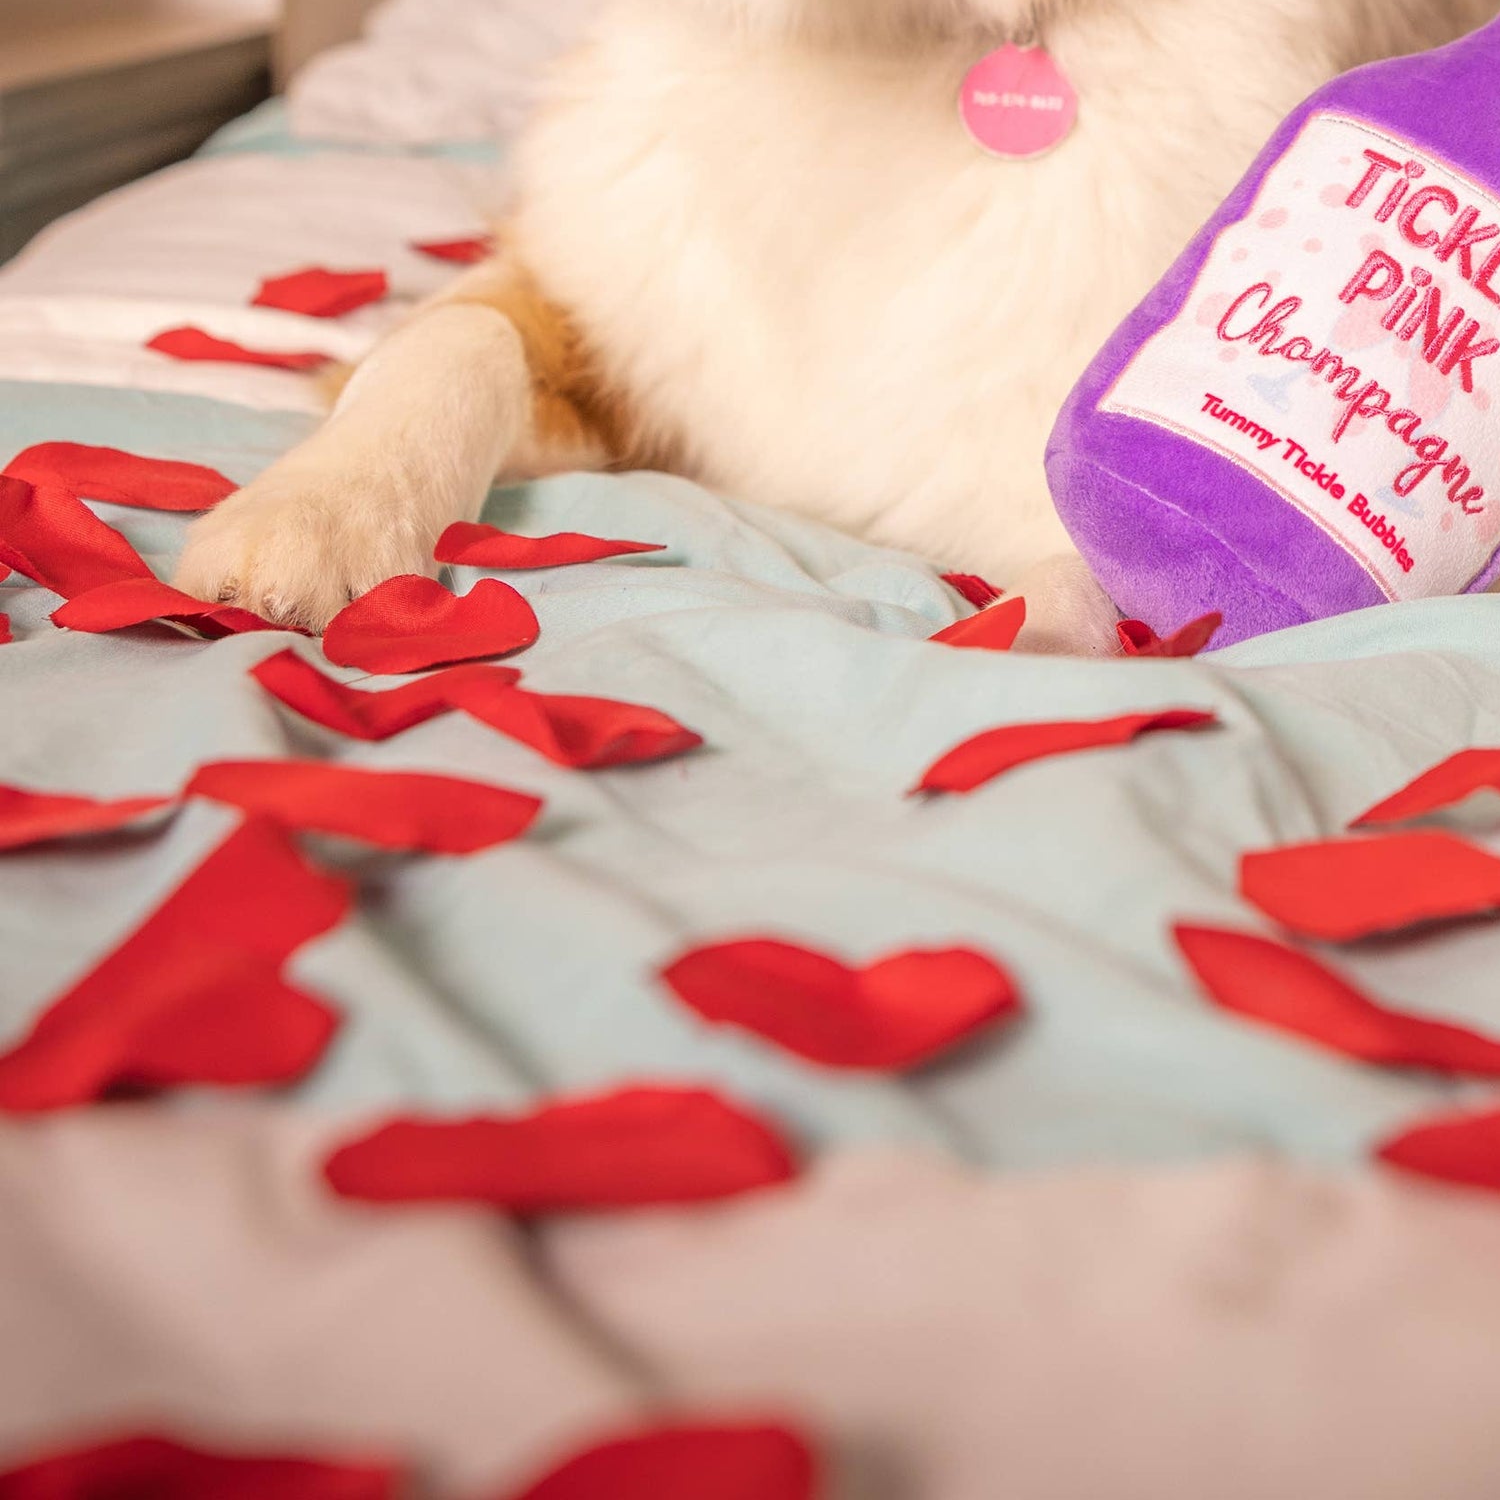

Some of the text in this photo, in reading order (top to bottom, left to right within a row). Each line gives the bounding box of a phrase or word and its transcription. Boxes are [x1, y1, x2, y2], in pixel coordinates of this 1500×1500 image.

[1200, 393, 1414, 572] Tummy Tickle Bubbles
